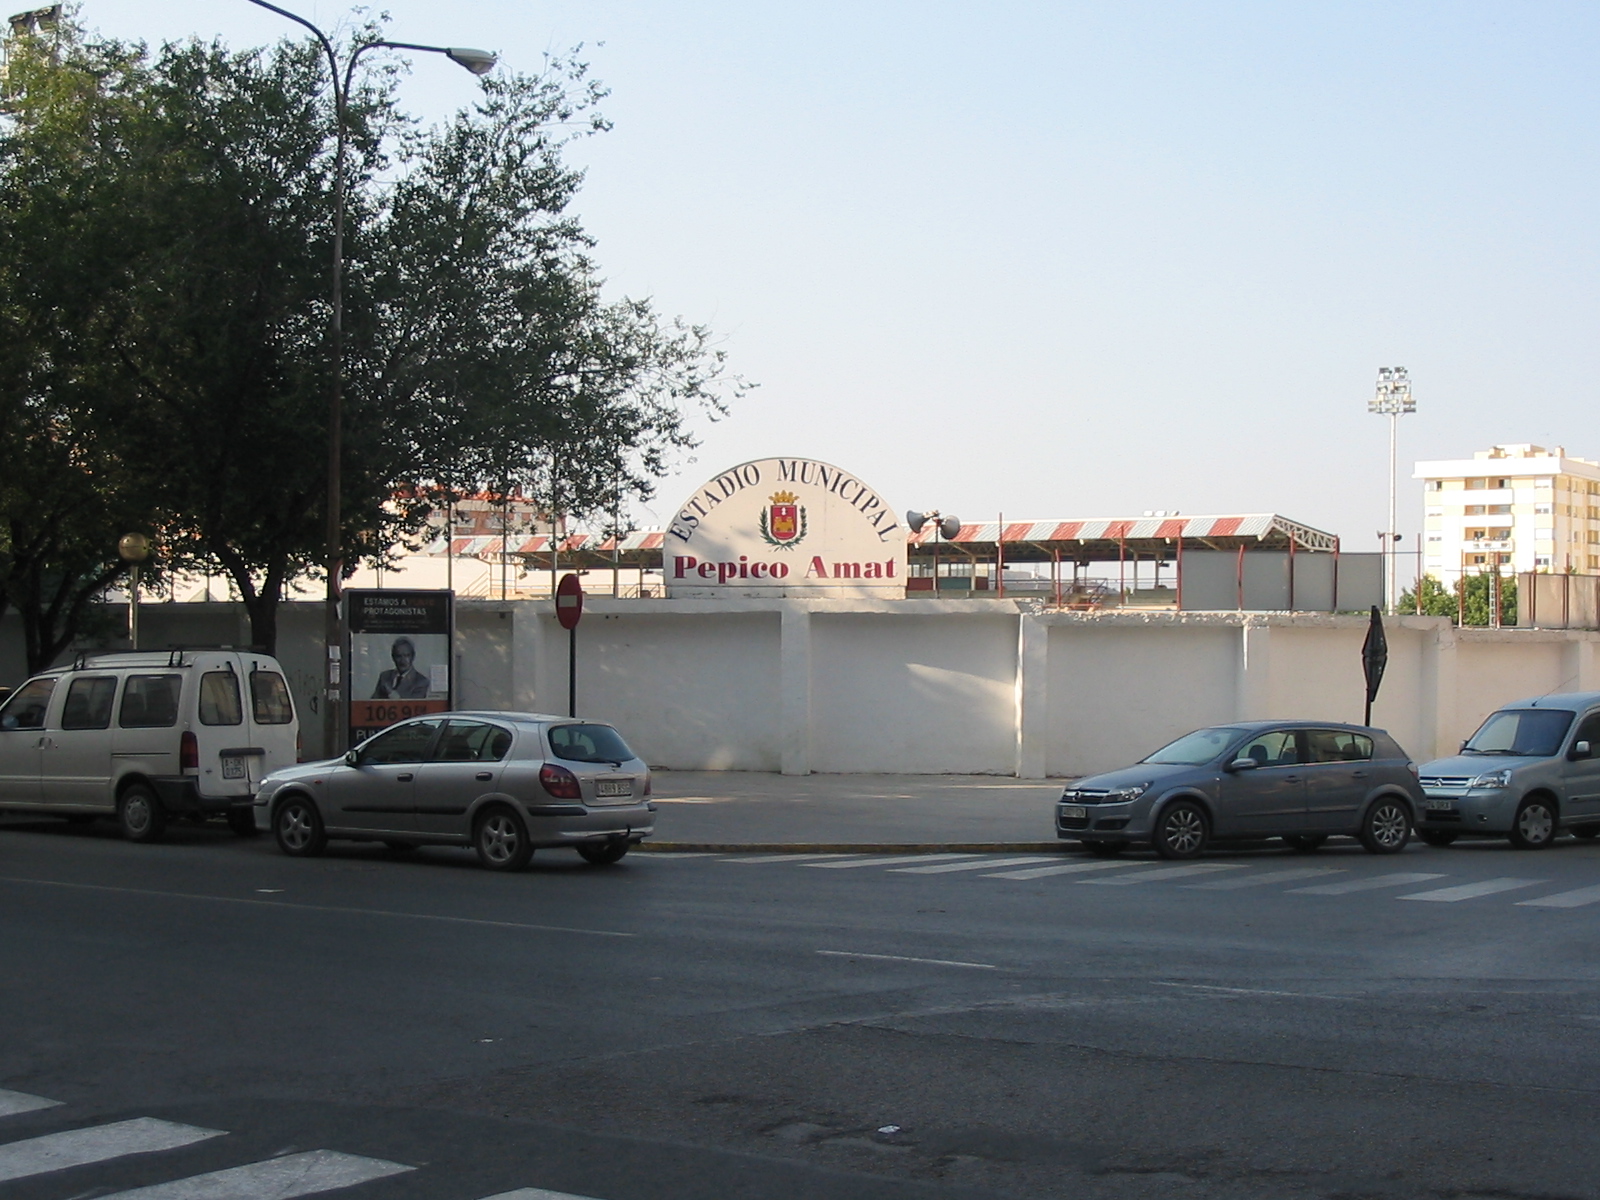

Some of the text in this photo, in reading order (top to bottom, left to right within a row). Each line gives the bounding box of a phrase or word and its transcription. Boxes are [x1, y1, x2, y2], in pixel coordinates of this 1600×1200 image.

[669, 460, 898, 543] ESTADIO MUNICIPAL
[673, 555, 898, 584] Pepico Amat
[363, 607, 427, 615] PROTAGONISTAS
